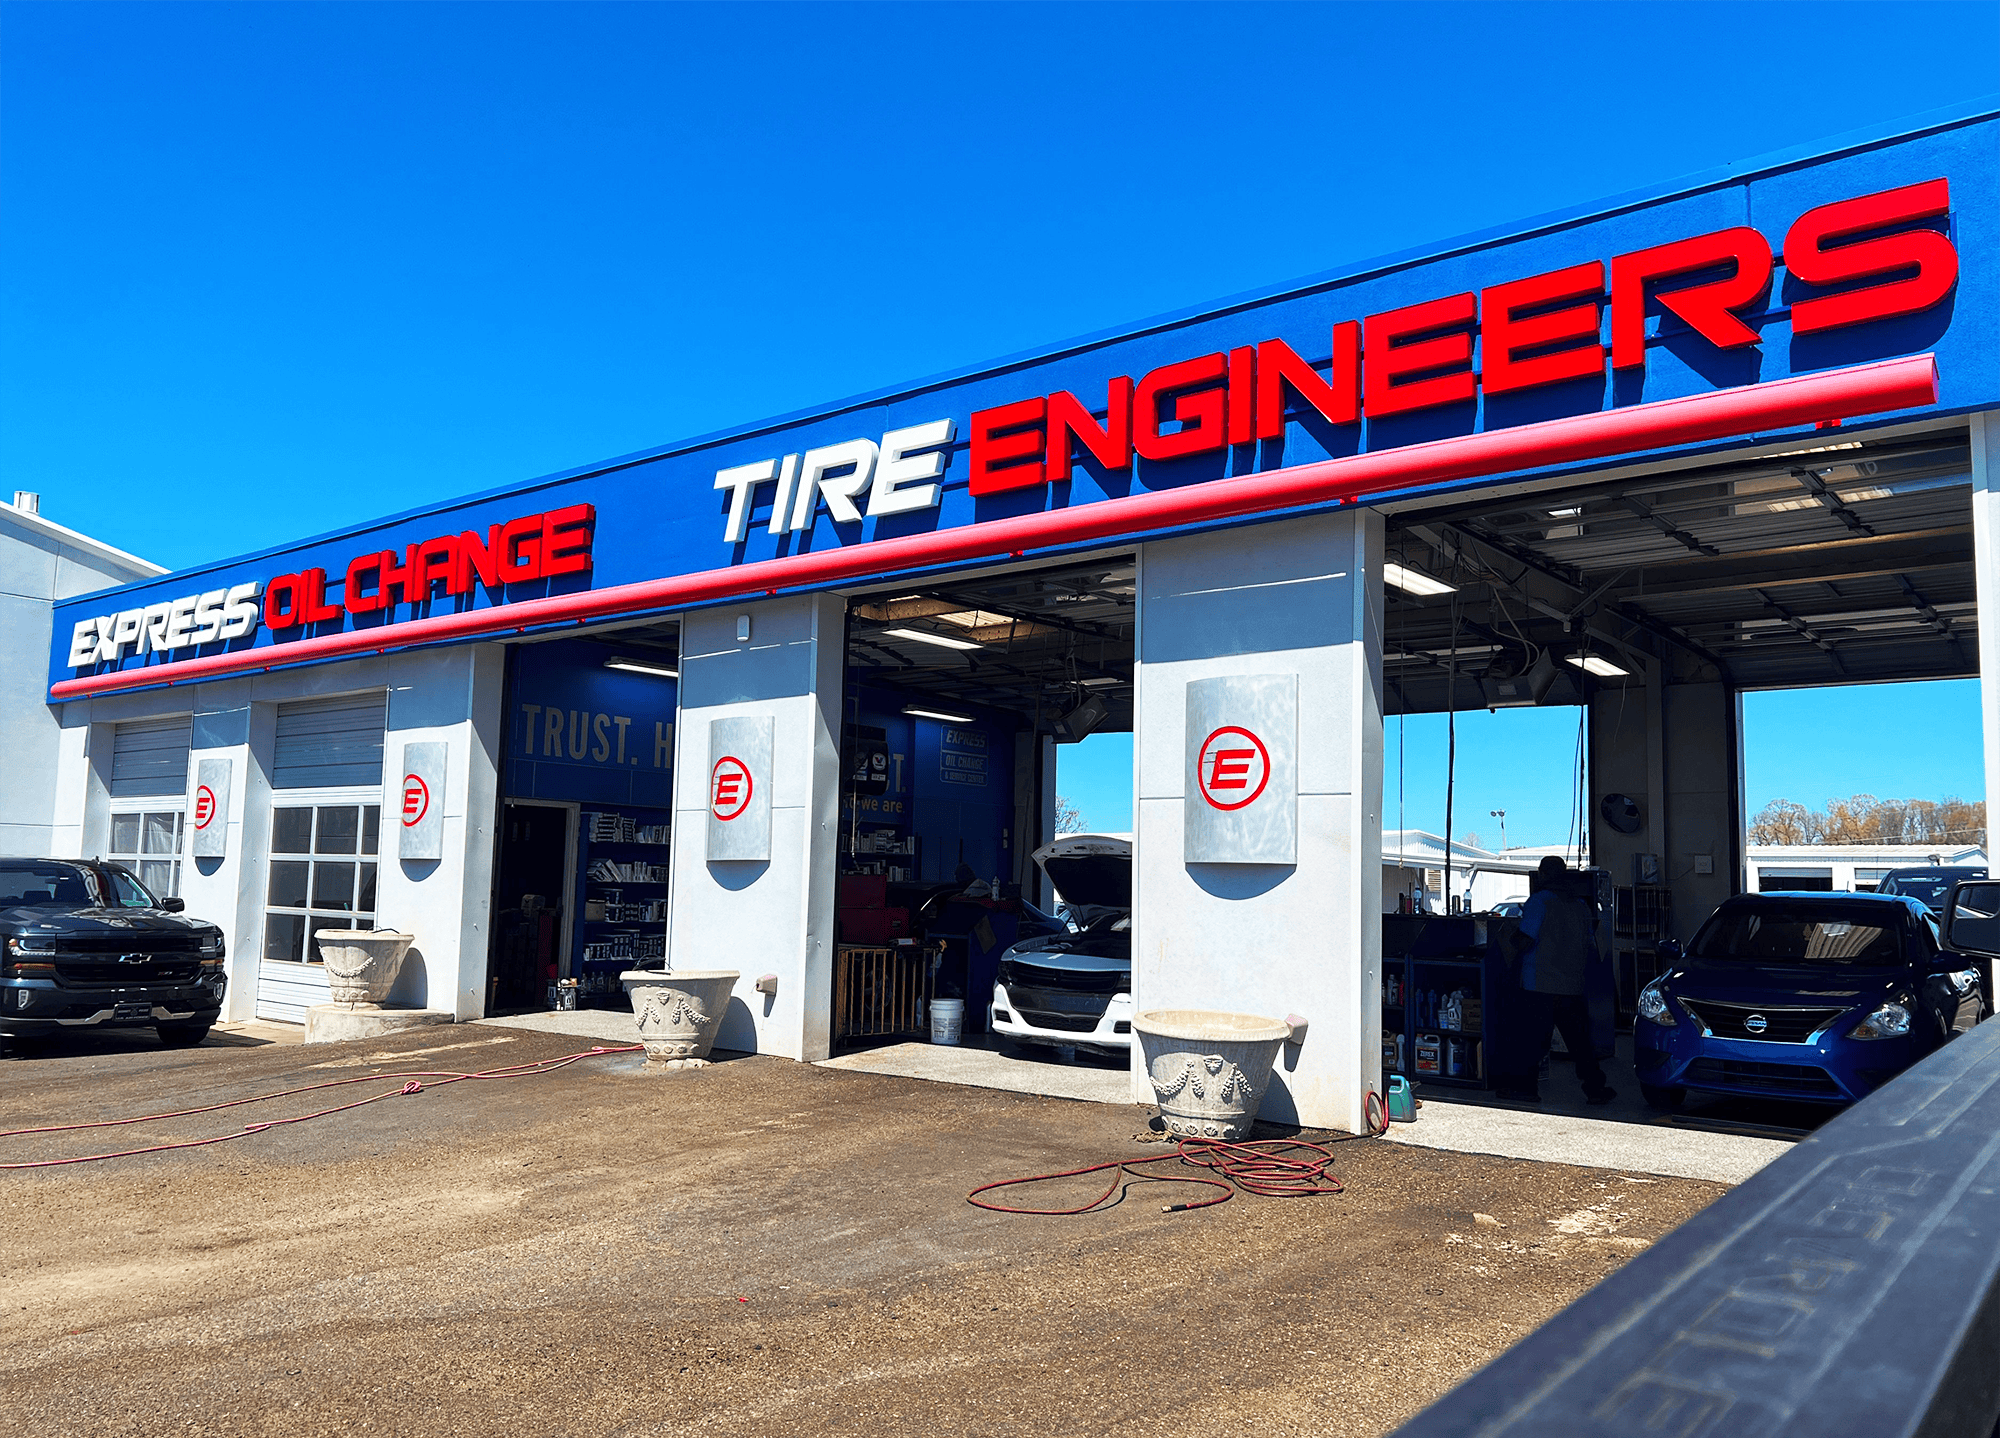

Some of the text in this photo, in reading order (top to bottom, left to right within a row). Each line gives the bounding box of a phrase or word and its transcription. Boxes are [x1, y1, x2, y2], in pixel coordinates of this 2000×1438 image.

[713, 177, 1959, 543] TIRE ENGINEERS
[67, 502, 596, 668] EXPRESS OIL CHANGE
[521, 703, 638, 766] TRUST.
[946, 729, 987, 748] EXPRESS
[945, 754, 985, 771] OIL CHANGE
[1209, 748, 1256, 790] E
[402, 788, 422, 814] E
[715, 773, 743, 805] E
[861, 798, 878, 811] we
